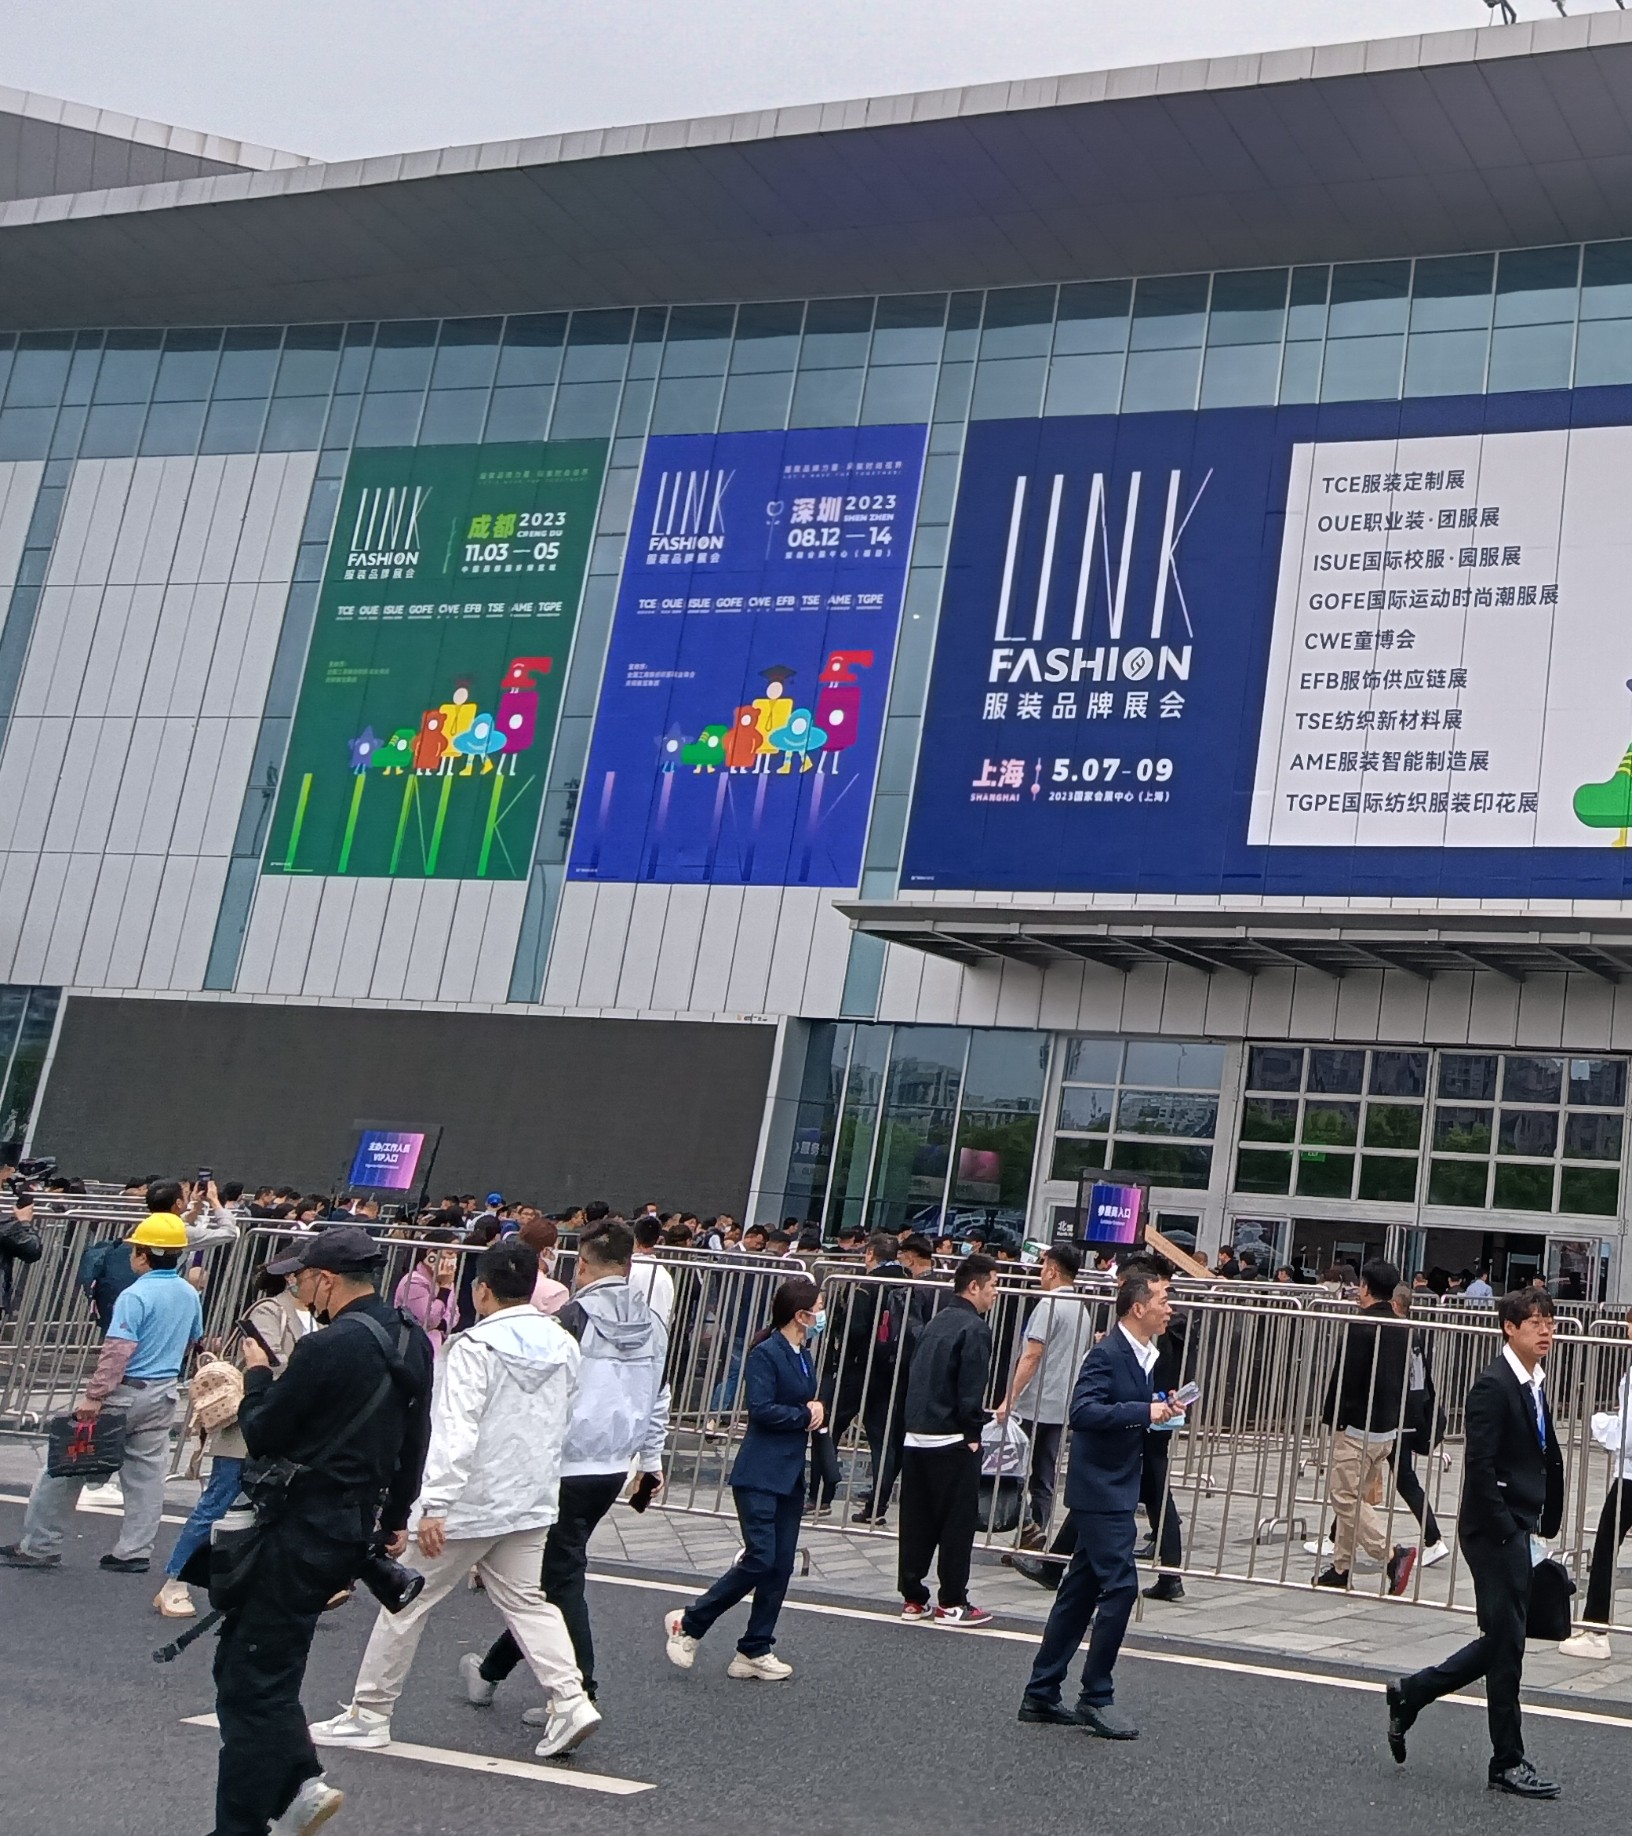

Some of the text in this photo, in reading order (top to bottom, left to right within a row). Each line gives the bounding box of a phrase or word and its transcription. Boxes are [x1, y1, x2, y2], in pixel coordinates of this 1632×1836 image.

[1322, 469, 1466, 494] TCE服装定制展
[651, 469, 736, 536] LINK
[790, 495, 897, 524] 深圳 2023
[350, 486, 433, 551] LINK
[467, 512, 567, 539] 成都 2023
[843, 513, 895, 522] SHEN ZHEN
[549, 529, 563, 537] DU
[649, 535, 725, 551] FASHION
[347, 552, 419, 566] FASHION
[994, 467, 1214, 642] LINK
[344, 568, 416, 580] 服装品牌展会
[337, 601, 563, 615] TCE OUE ISUE GOFE CWE EFB TSE AME TGPE
[639, 594, 884, 609] TCE OUE ISUE GOFE CWE EFB TSE AME TGPE
[1308, 584, 1559, 611] GOFE国际运动时尚潮服展
[1304, 629, 1416, 650] CWE童博会
[988, 645, 1192, 683] FASHION
[1299, 668, 1468, 691] EFB服饰供应链展
[982, 690, 1185, 720] 服装品牌展会
[1295, 709, 1463, 731] TSE纺织新材料展
[972, 758, 1174, 788] 上海 5.07-09
[1289, 750, 1490, 773] AME服装智能制造展
[970, 793, 1020, 802] SHANGHAI
[1285, 792, 1539, 814] TGPE国际纺织服装印花展
